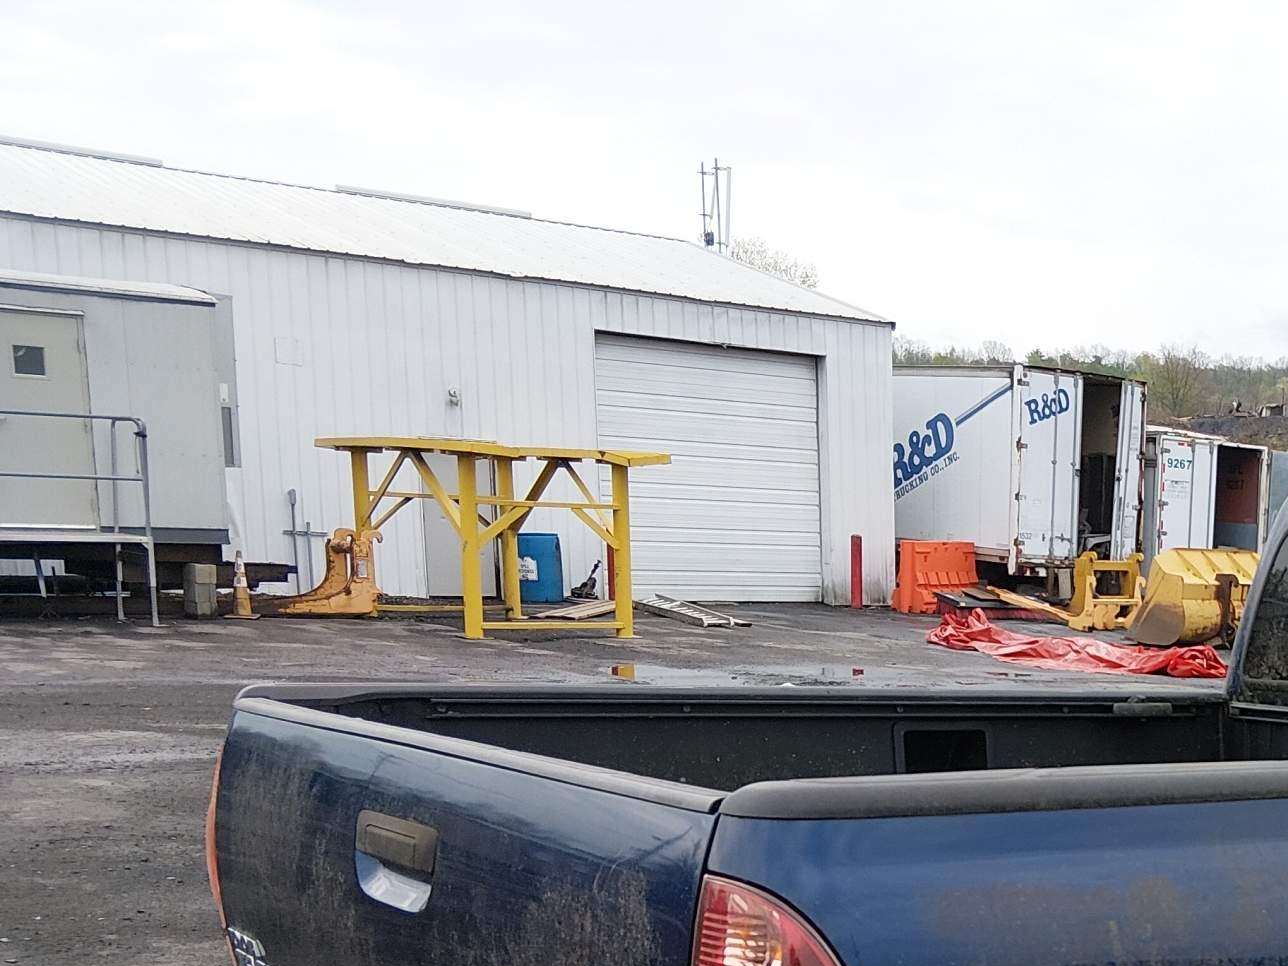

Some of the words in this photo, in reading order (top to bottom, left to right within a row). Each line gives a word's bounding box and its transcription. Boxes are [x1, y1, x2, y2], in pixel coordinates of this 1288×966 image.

[1024, 388, 1070, 425] R&D
[893, 412, 954, 490] R&D
[1167, 457, 1193, 470] 9267
[895, 471, 929, 501] RUCKING
